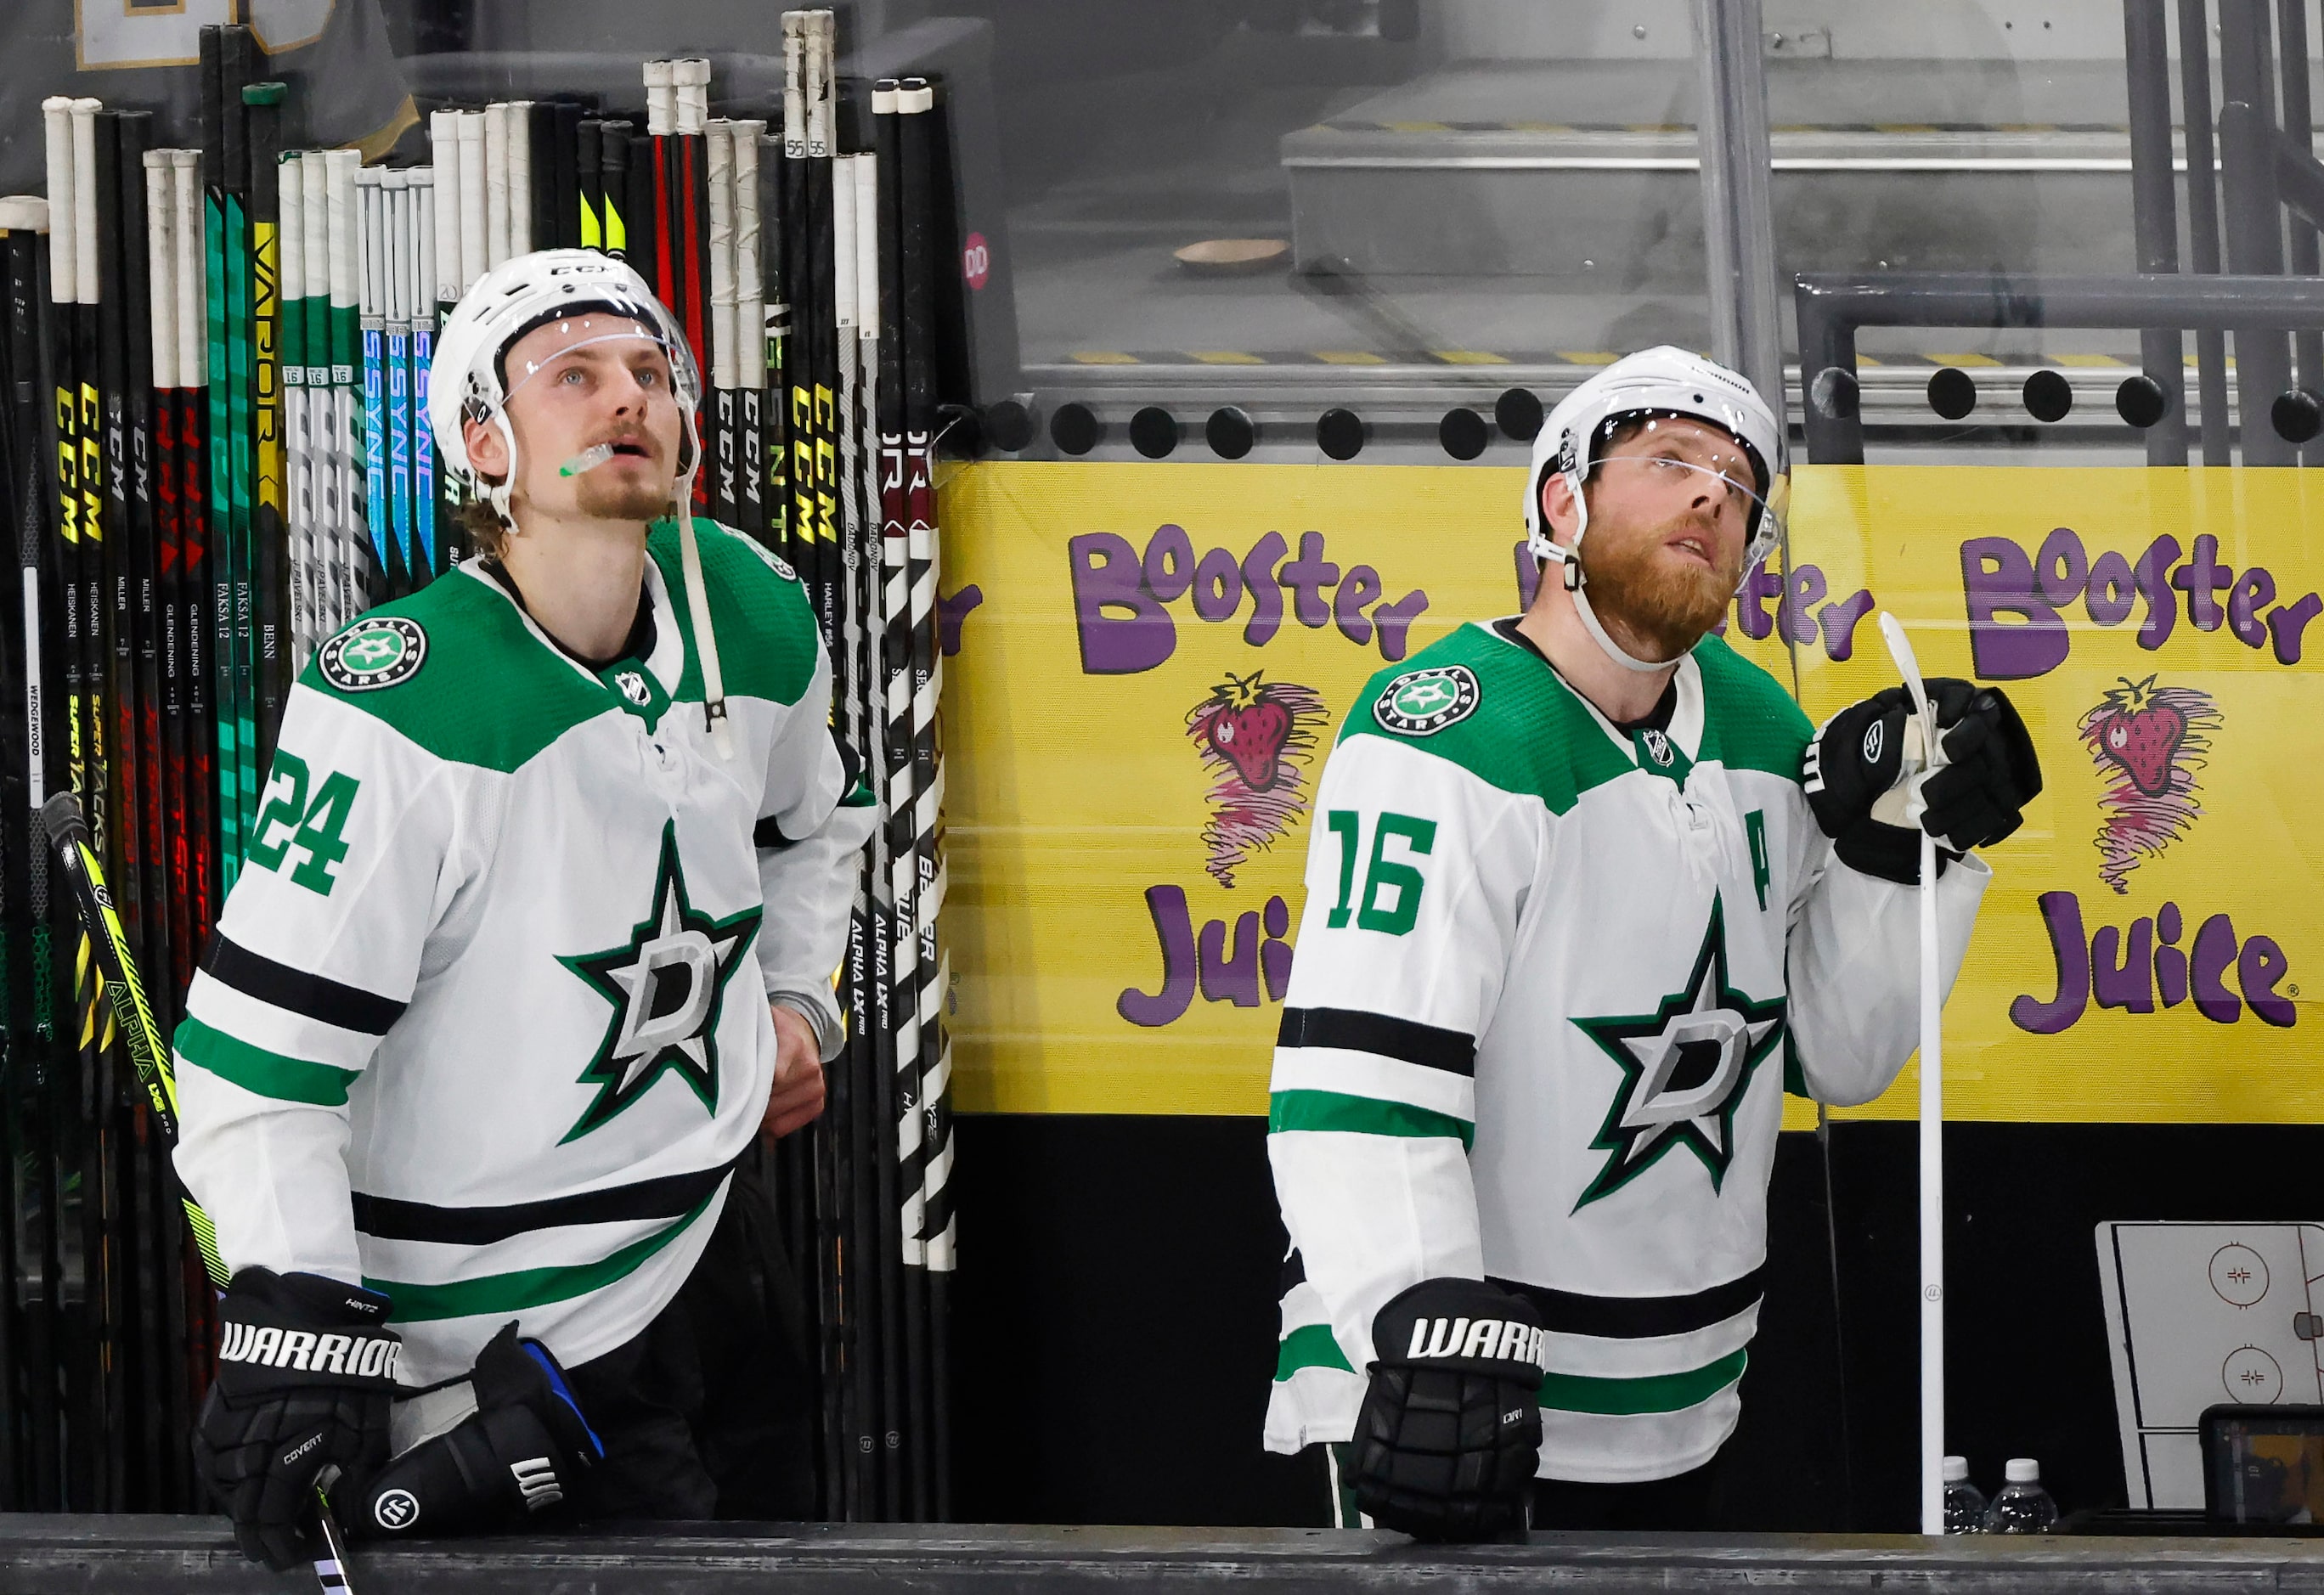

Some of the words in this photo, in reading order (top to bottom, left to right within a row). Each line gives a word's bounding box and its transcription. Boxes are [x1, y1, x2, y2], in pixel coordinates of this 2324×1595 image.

[786, 139, 804, 156] 55
[809, 140, 825, 155] 55
[255, 236, 276, 446] VAPOR
[286, 372, 298, 382] 16
[310, 374, 322, 384] 16
[336, 371, 347, 381] 16
[56, 386, 79, 544] CCM
[82, 382, 103, 542] CCM
[719, 391, 735, 504] CCM
[744, 391, 761, 504] CCM
[793, 385, 815, 544] CCM
[815, 382, 838, 543] CCM
[847, 521, 857, 572] DADONOV
[67, 583, 77, 638] HEISKANEN
[90, 582, 99, 637] HEISKANEN
[117, 576, 127, 610] MILLER
[142, 578, 150, 612] MILLER
[217, 583, 230, 622] FAKSA
[237, 582, 249, 621] FAKSA
[824, 582, 833, 625] HARLEY
[1069, 524, 1428, 674] Booster
[1960, 527, 2323, 679] Booster
[166, 604, 176, 678] GLENDENING
[190, 604, 200, 677] GLENDENING
[218, 626, 230, 639] 12
[238, 626, 249, 638] 12
[262, 624, 275, 659] BENN
[325, 650, 392, 685] STARS
[30, 685, 40, 756] WEDGEWOOD
[70, 694, 80, 758] SUPER
[92, 694, 102, 757] SUPER
[1379, 698, 1447, 730] STARS
[246, 747, 360, 897] 24
[1326, 810, 1438, 937] 16
[851, 919, 865, 983] ALPHA
[875, 913, 888, 977] ALPHA
[2008, 890, 2296, 1034] Juice
[853, 987, 865, 1015] LX
[876, 982, 888, 1008] LX
[105, 980, 156, 1083] ALPHA
[219, 1321, 403, 1379] WARRIOR
[284, 1432, 323, 1465] COVERT
